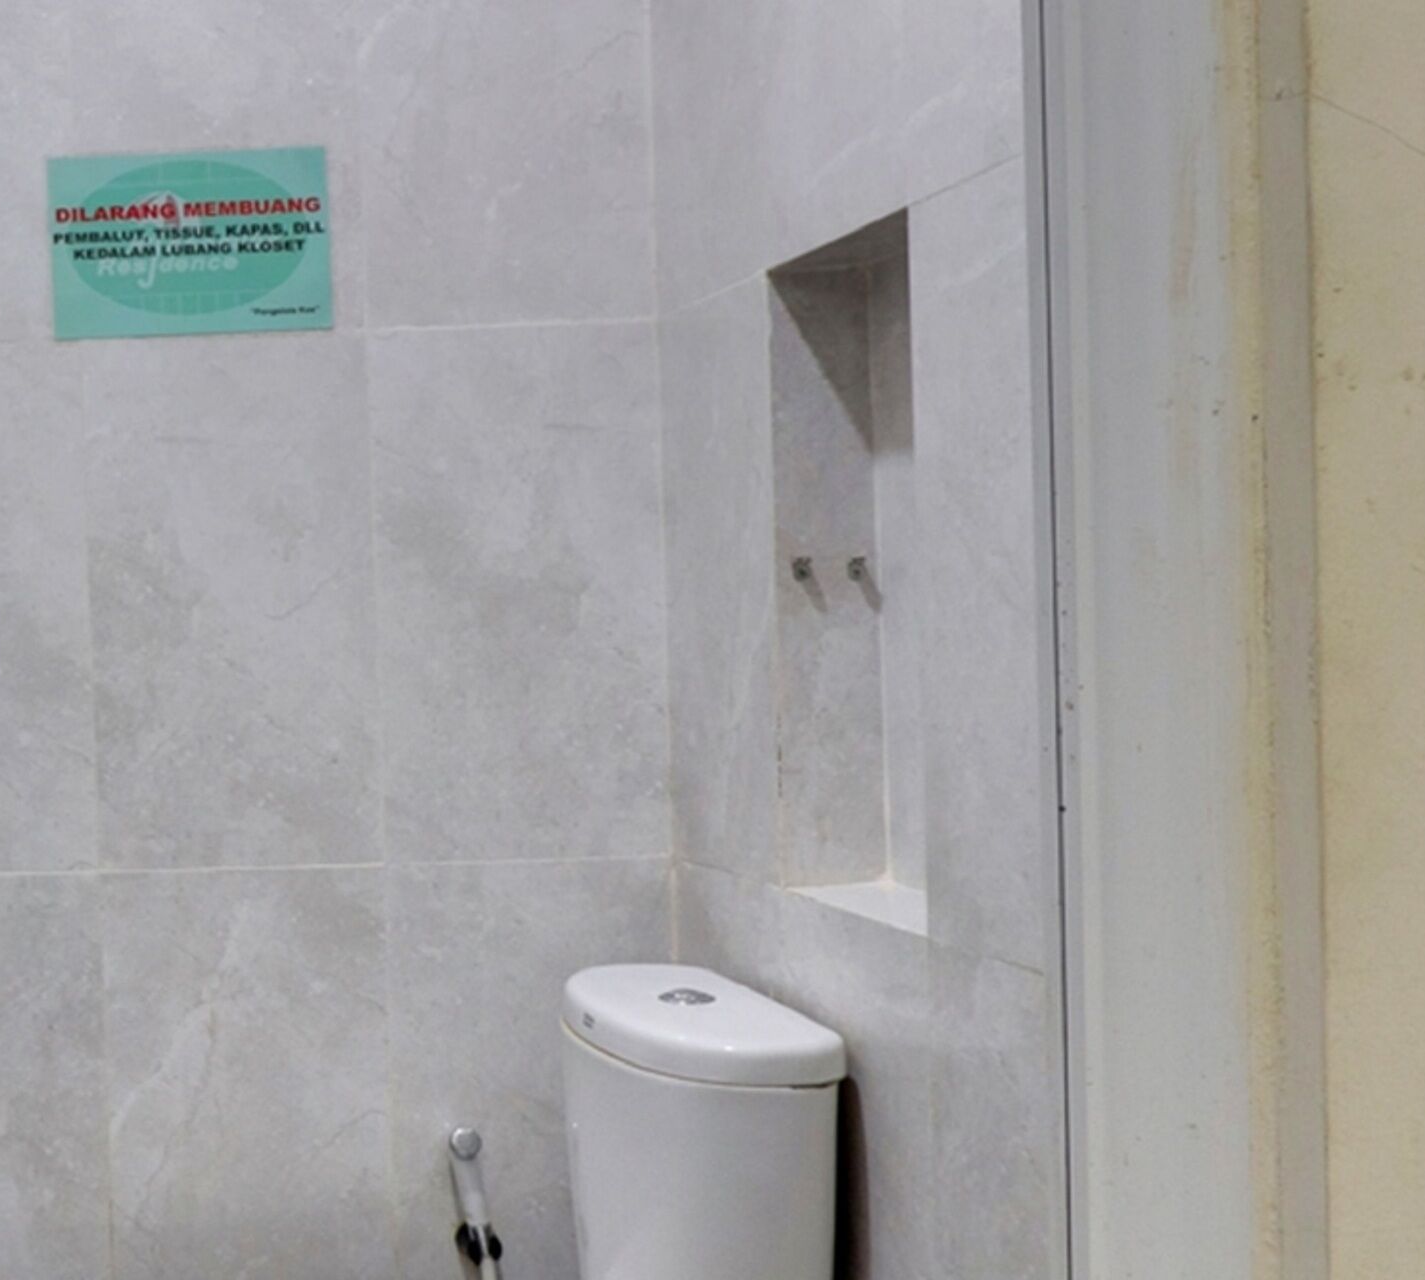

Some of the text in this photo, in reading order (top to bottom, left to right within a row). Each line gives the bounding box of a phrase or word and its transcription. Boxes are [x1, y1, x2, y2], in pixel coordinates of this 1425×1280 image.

[55, 196, 321, 223] DILARANG MEMBUANG
[53, 228, 149, 244] PEMBALUT,
[154, 224, 221, 240] TISSUE,
[225, 222, 289, 237] KAPAS,
[292, 221, 325, 235] DLL
[73, 244, 157, 260] KEDALAM
[161, 241, 232, 257] LUBANG
[237, 238, 306, 254] KLOSET
